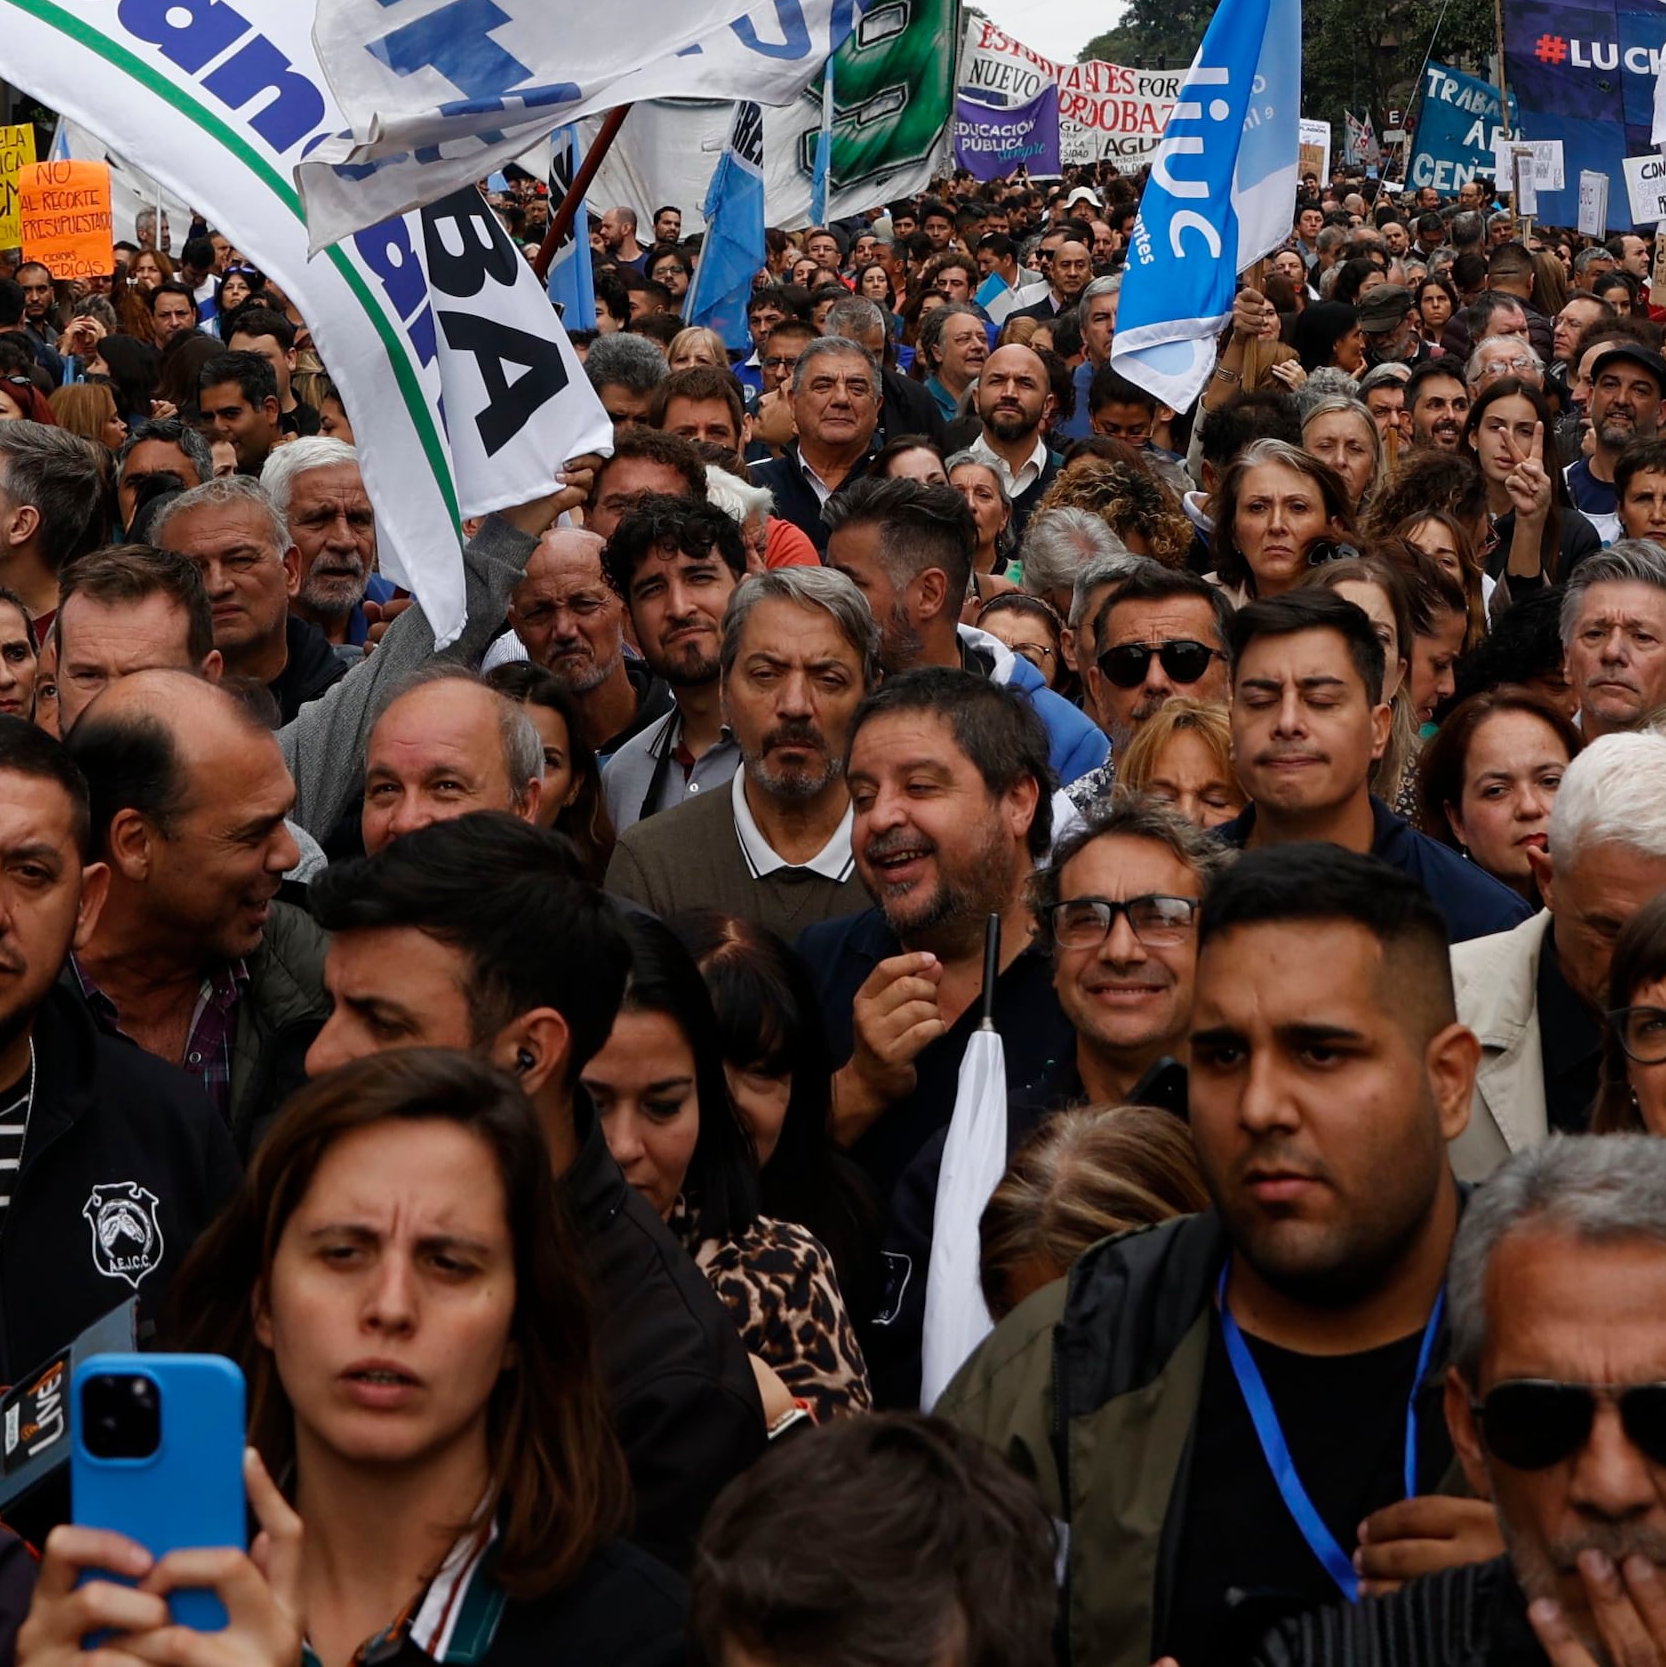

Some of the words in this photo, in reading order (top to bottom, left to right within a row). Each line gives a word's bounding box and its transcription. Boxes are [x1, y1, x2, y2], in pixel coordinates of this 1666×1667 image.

[977, 22, 1136, 96] ESTUDIANTES
[1139, 77, 1179, 98] POR
[968, 58, 1040, 98] NUEVO
[954, 119, 1036, 139] EDUCACIÓN
[1389, 110, 1400, 124] E
[36, 160, 72, 185] NO
[21, 194, 38, 212] AL
[42, 189, 101, 212] RECORTE
